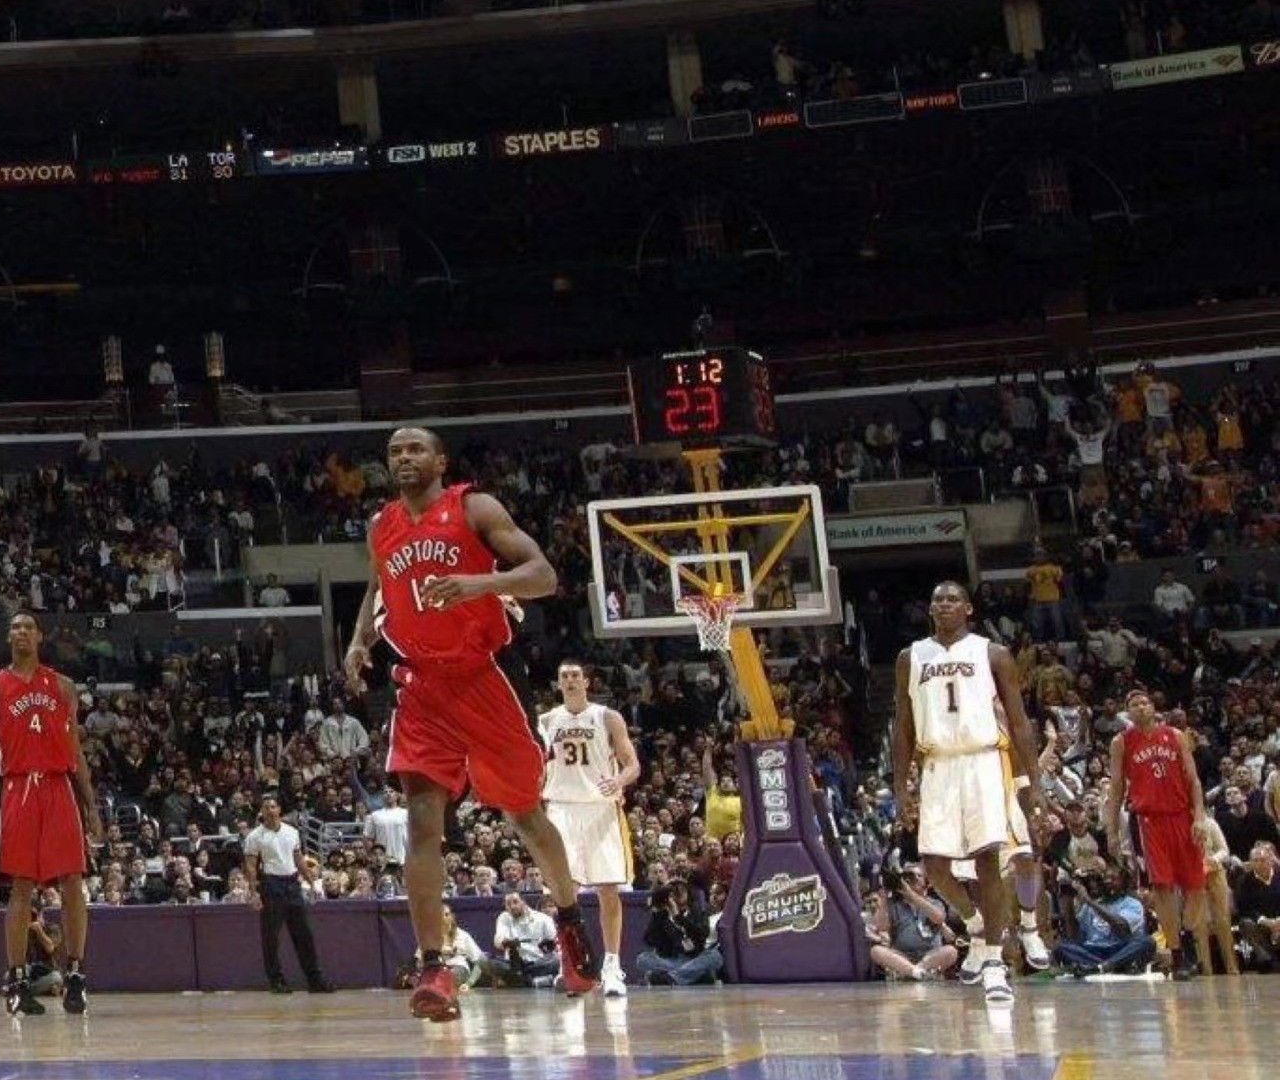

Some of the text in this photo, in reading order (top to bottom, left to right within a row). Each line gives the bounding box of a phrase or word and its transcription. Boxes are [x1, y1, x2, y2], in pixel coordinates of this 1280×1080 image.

[390, 141, 477, 162] FSN WEST 2
[504, 128, 601, 157] STAPLES
[168, 154, 189, 168] LA
[207, 151, 237, 166] TOR
[291, 149, 355, 168] PEPSI
[1, 164, 76, 183] TOYOTA
[666, 386, 720, 432] 23
[861, 525, 874, 538] of
[875, 524, 927, 537] America
[385, 538, 461, 580] RAPTORS
[918, 661, 976, 685] LAKERS
[8, 691, 58, 718] RAPTORS
[946, 682, 958, 713] 1
[29, 713, 42, 734] 4
[562, 741, 590, 766] 31
[754, 901, 815, 924] DRAFT
